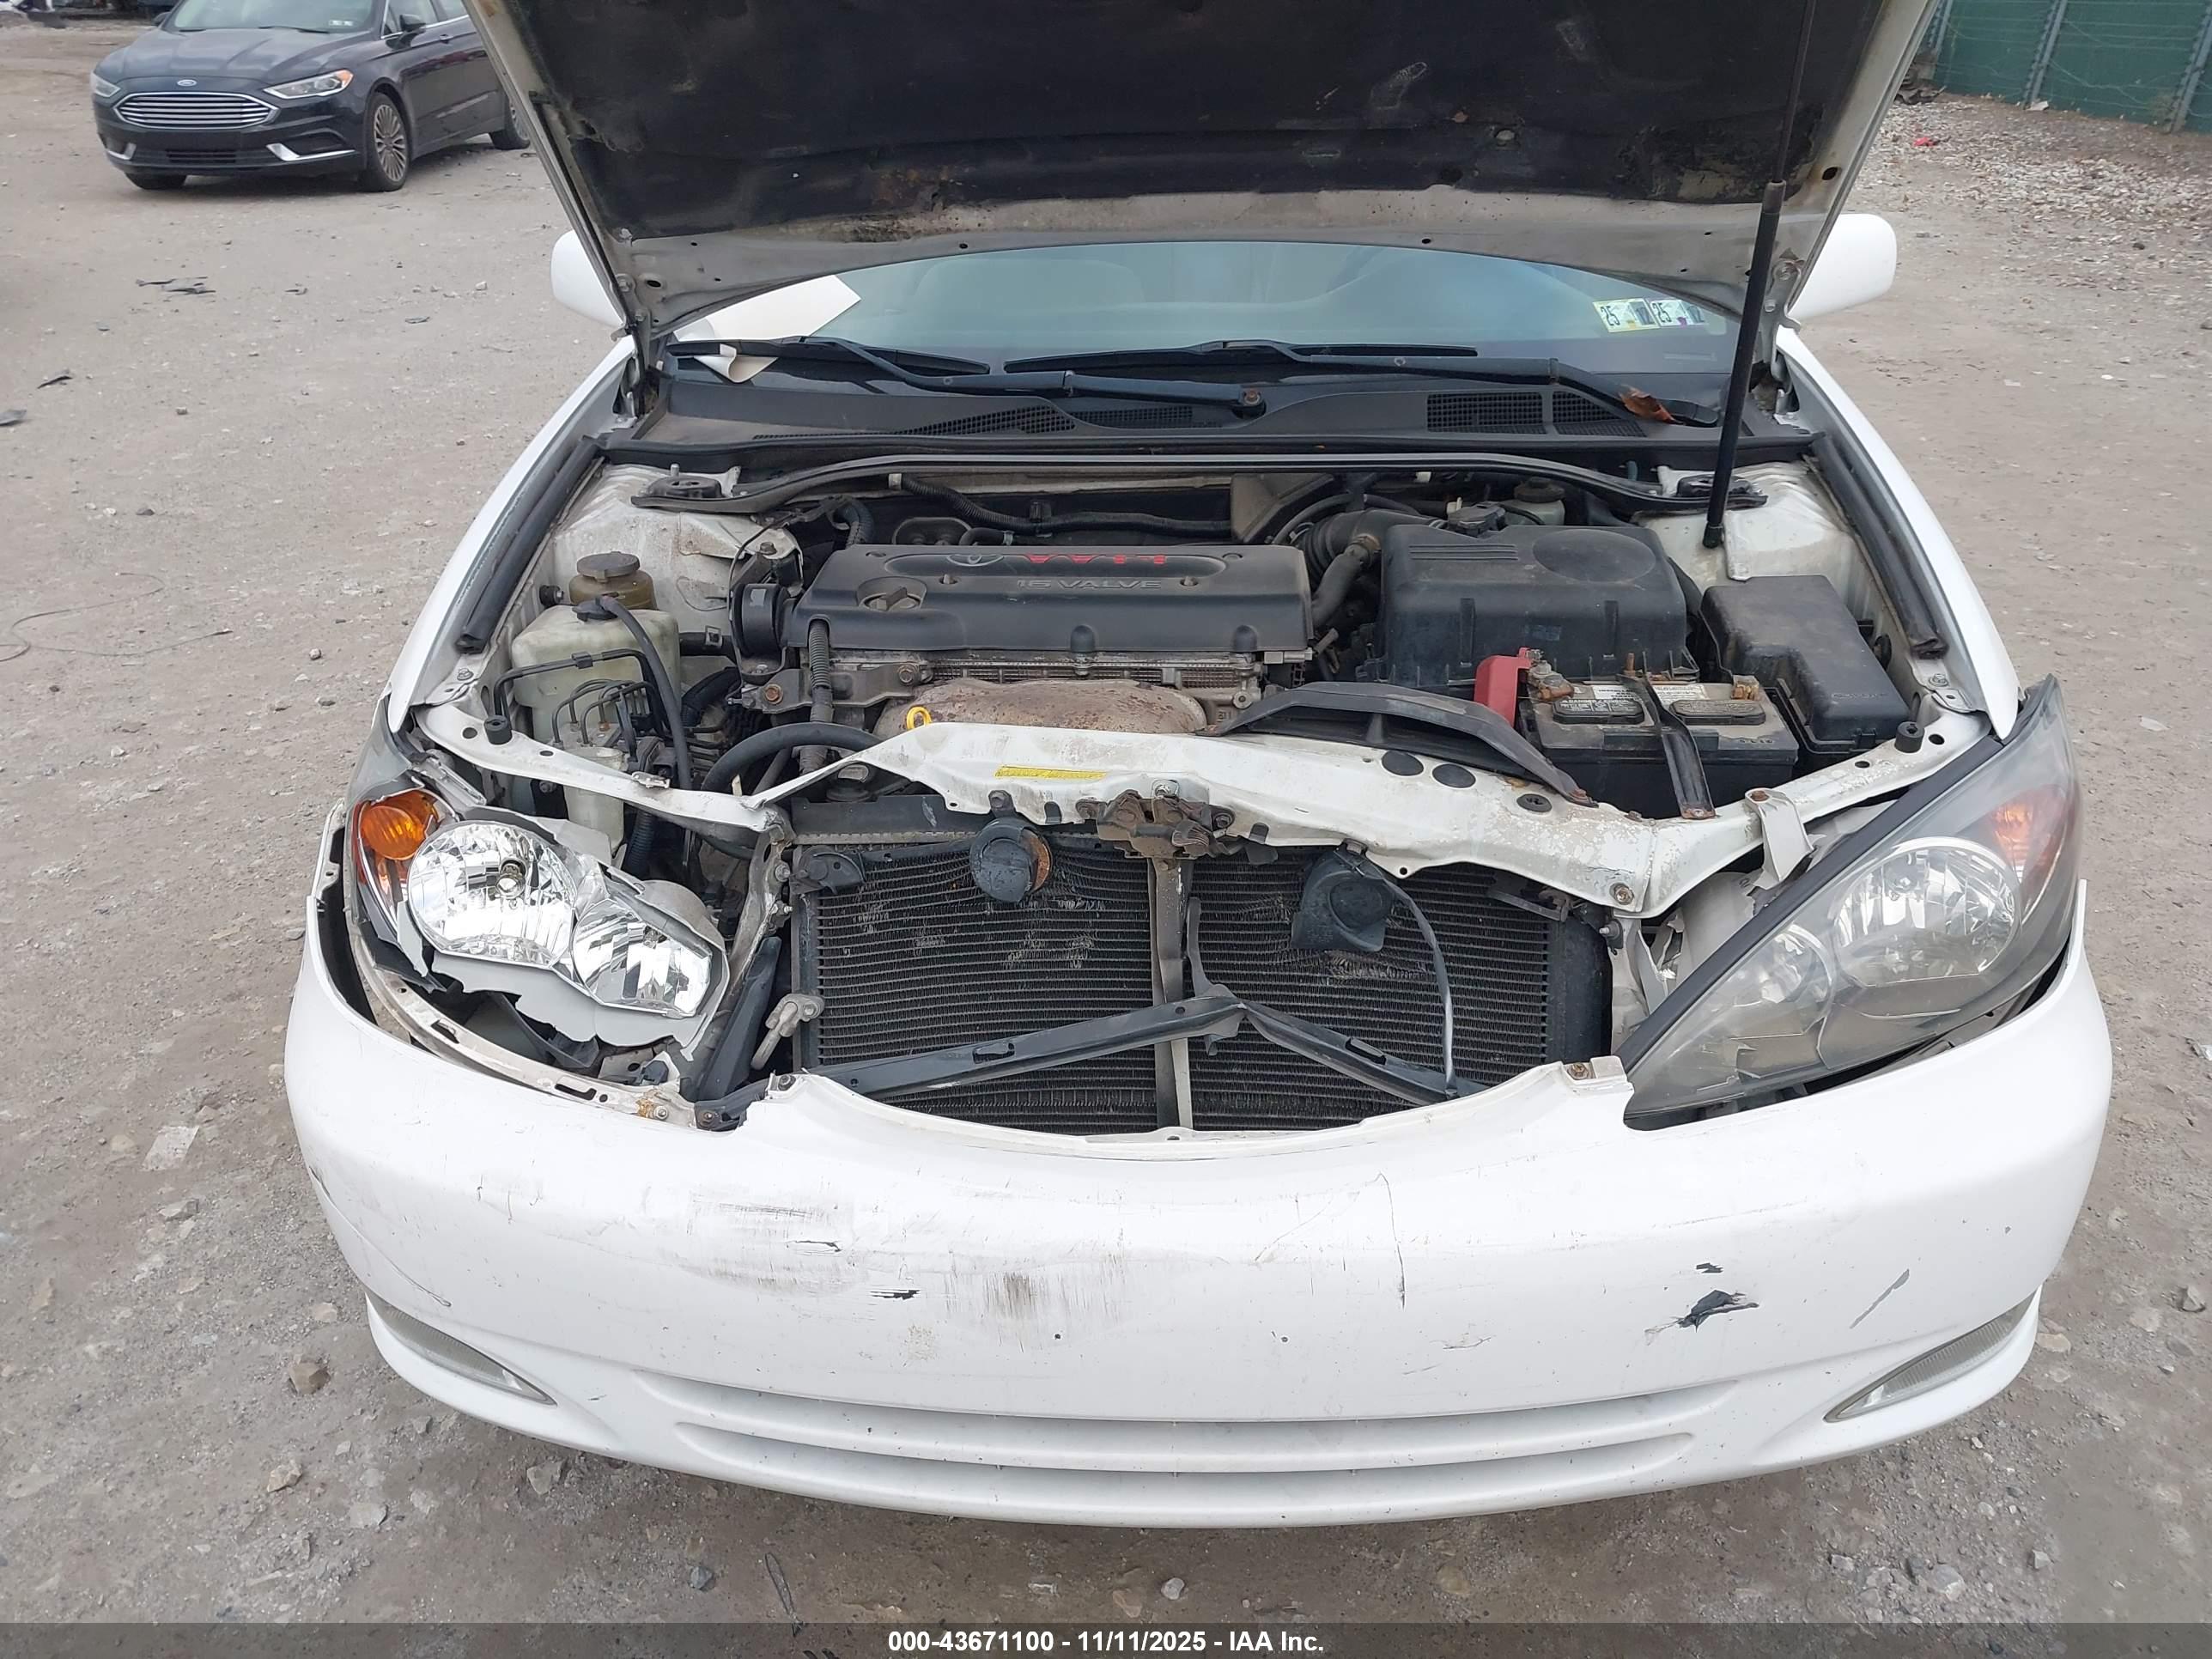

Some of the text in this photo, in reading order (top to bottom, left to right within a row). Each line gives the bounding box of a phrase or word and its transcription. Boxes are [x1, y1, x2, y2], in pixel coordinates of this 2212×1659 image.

[1600, 305, 1621, 326] 25
[1652, 302, 1672, 323] 25
[1057, 579, 1162, 589] VALVE
